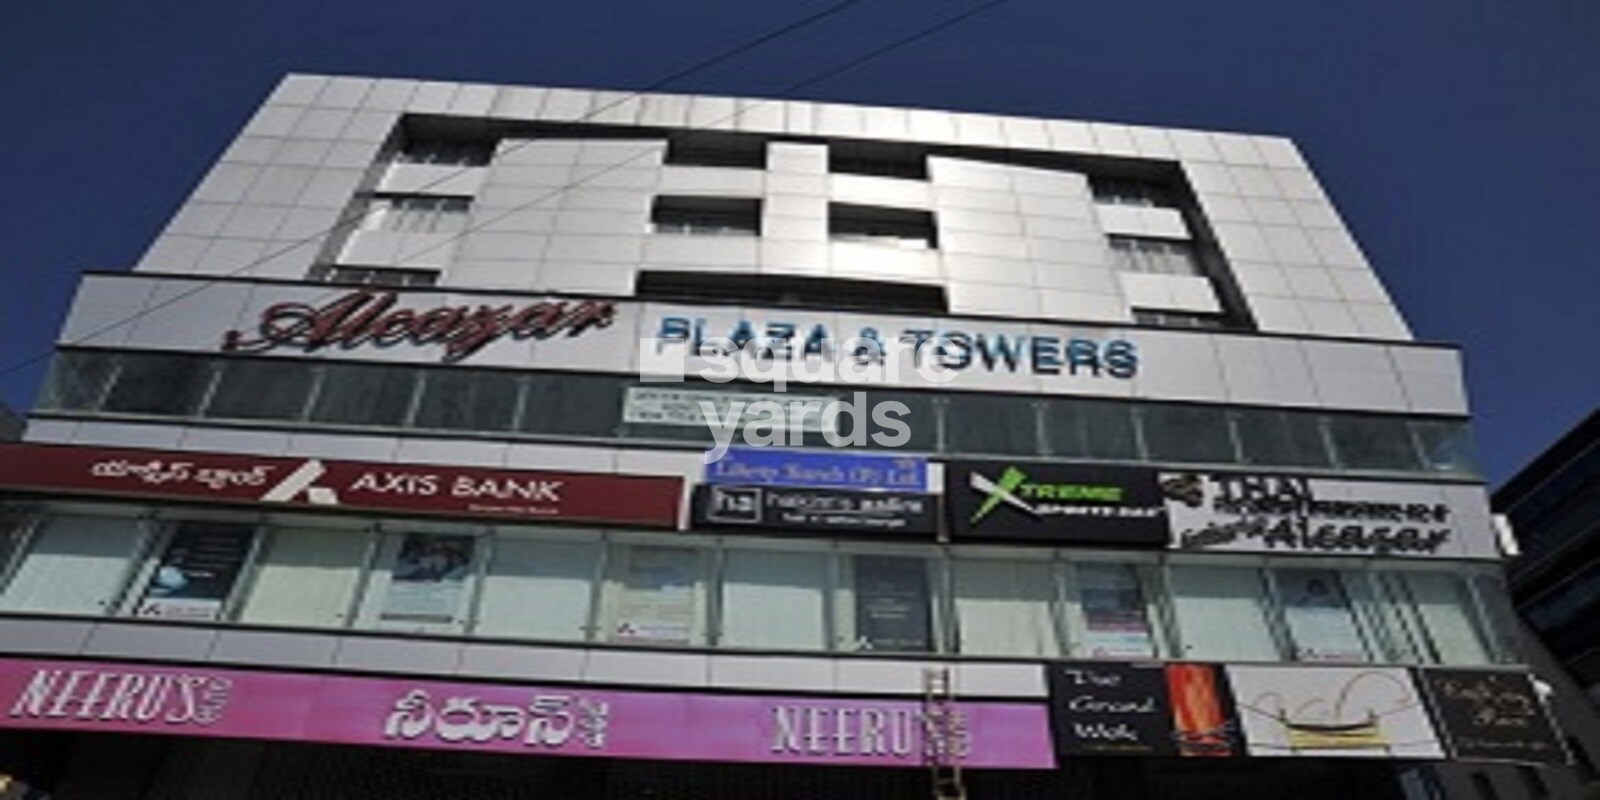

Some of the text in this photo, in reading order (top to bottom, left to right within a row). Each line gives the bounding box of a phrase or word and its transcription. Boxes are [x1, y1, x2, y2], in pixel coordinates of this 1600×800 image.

[222, 284, 616, 363] Alcazar
[655, 316, 1139, 380] PLAZA & TOWERS
[348, 471, 564, 502] AXIS BANK
